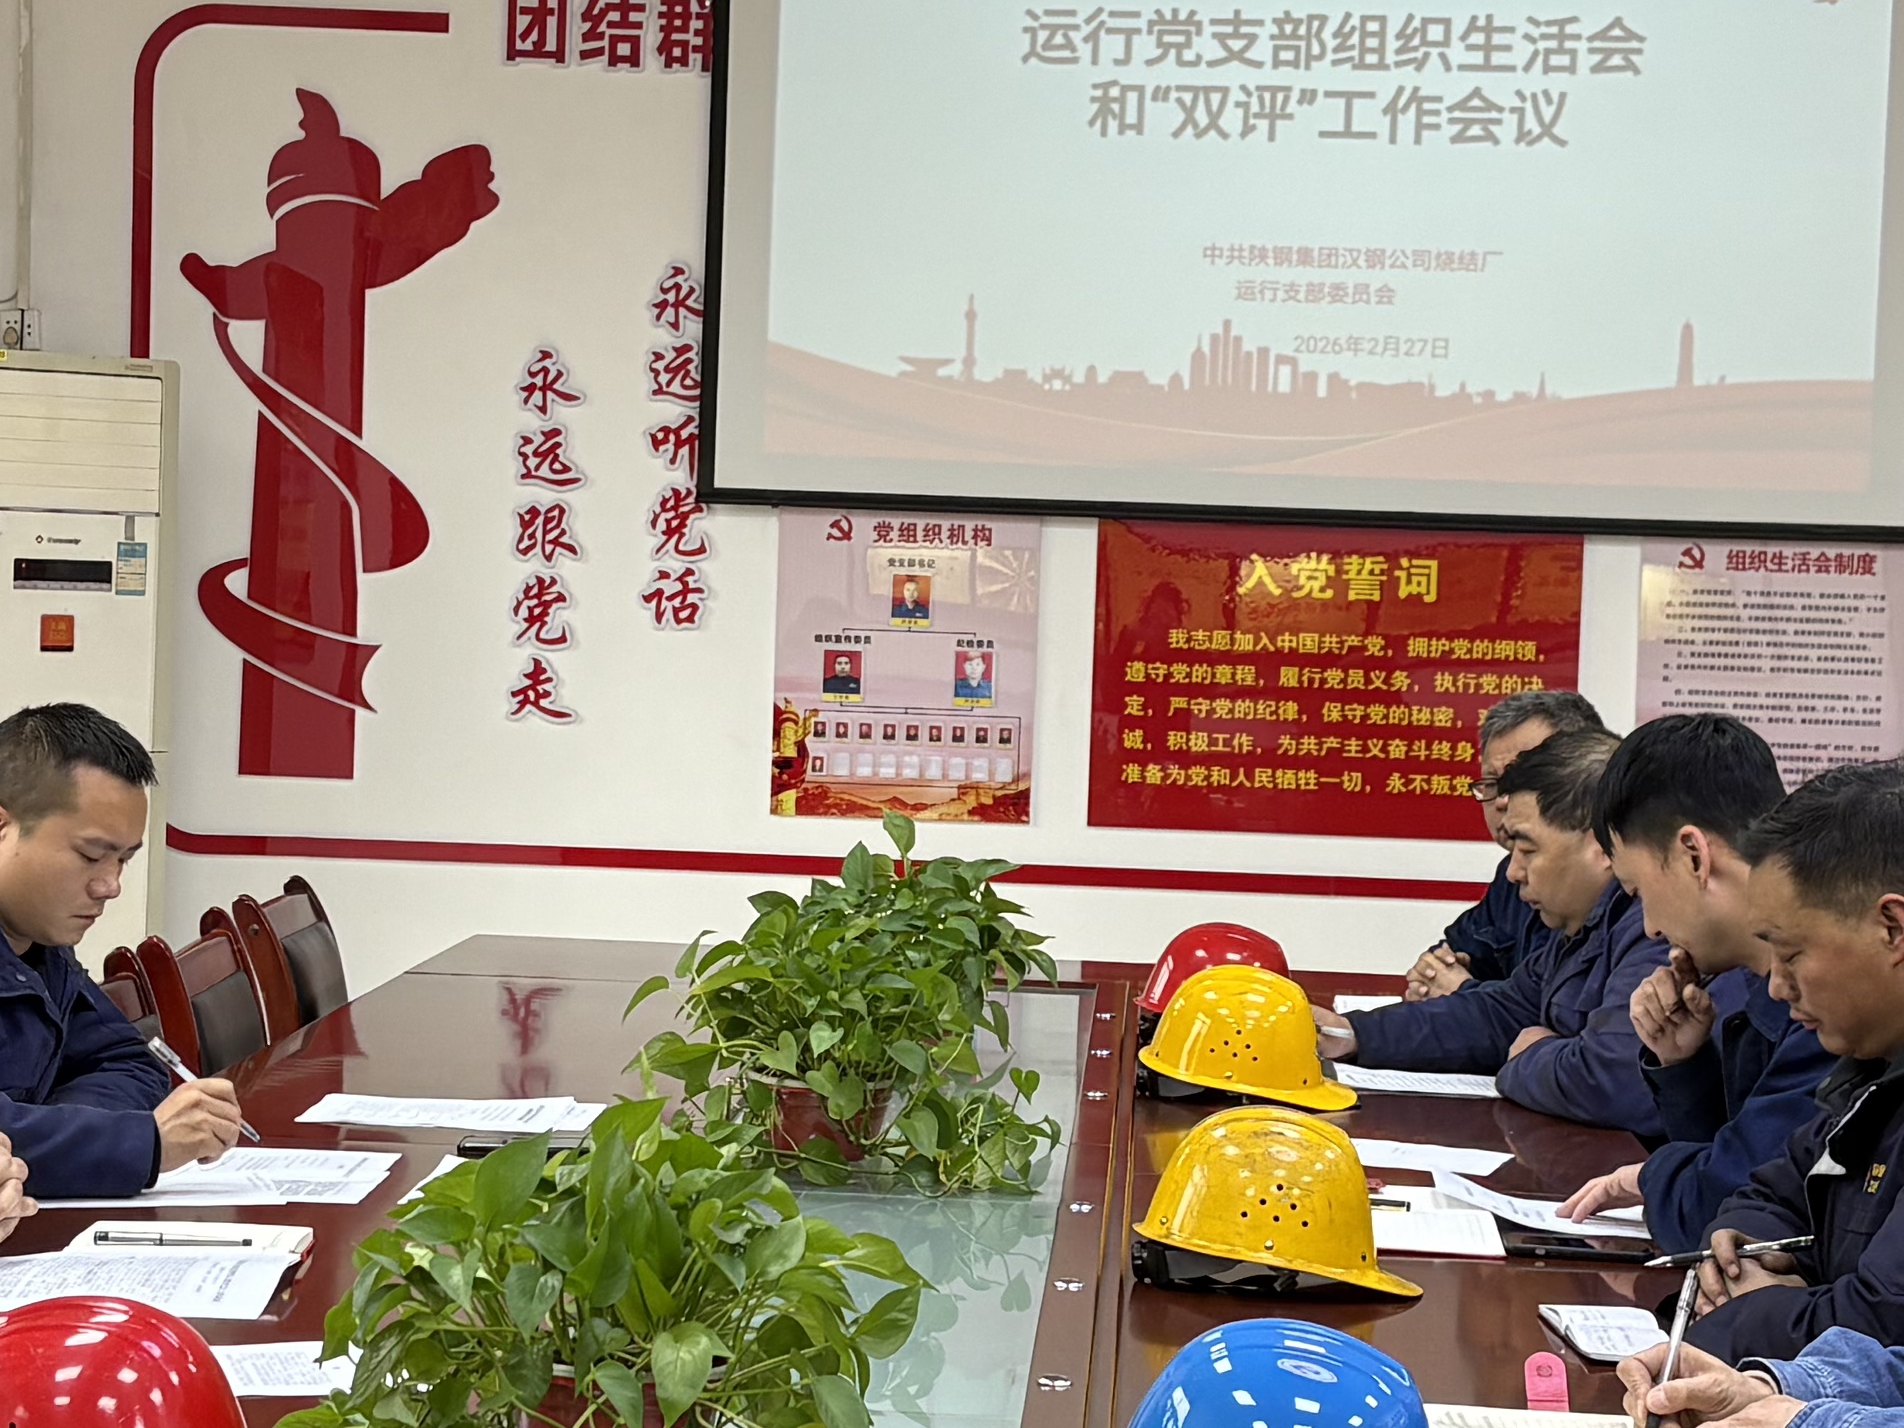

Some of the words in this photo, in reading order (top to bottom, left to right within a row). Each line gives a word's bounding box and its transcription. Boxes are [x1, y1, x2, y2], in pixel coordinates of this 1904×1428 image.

[1020, 8, 1647, 77] 运行党支部组织生活会
[1086, 81, 1570, 148] 和“双评”工作会议
[1234, 280, 1396, 306] 运行支部委员会
[1293, 335, 1450, 359] 2026年2月27日
[641, 266, 709, 627] 永远听党话
[510, 350, 582, 719] 永远跟党走
[872, 520, 993, 547] 党组织机构
[1238, 553, 1439, 603] 入党誓词
[1726, 548, 1878, 576] 组织生活会制度
